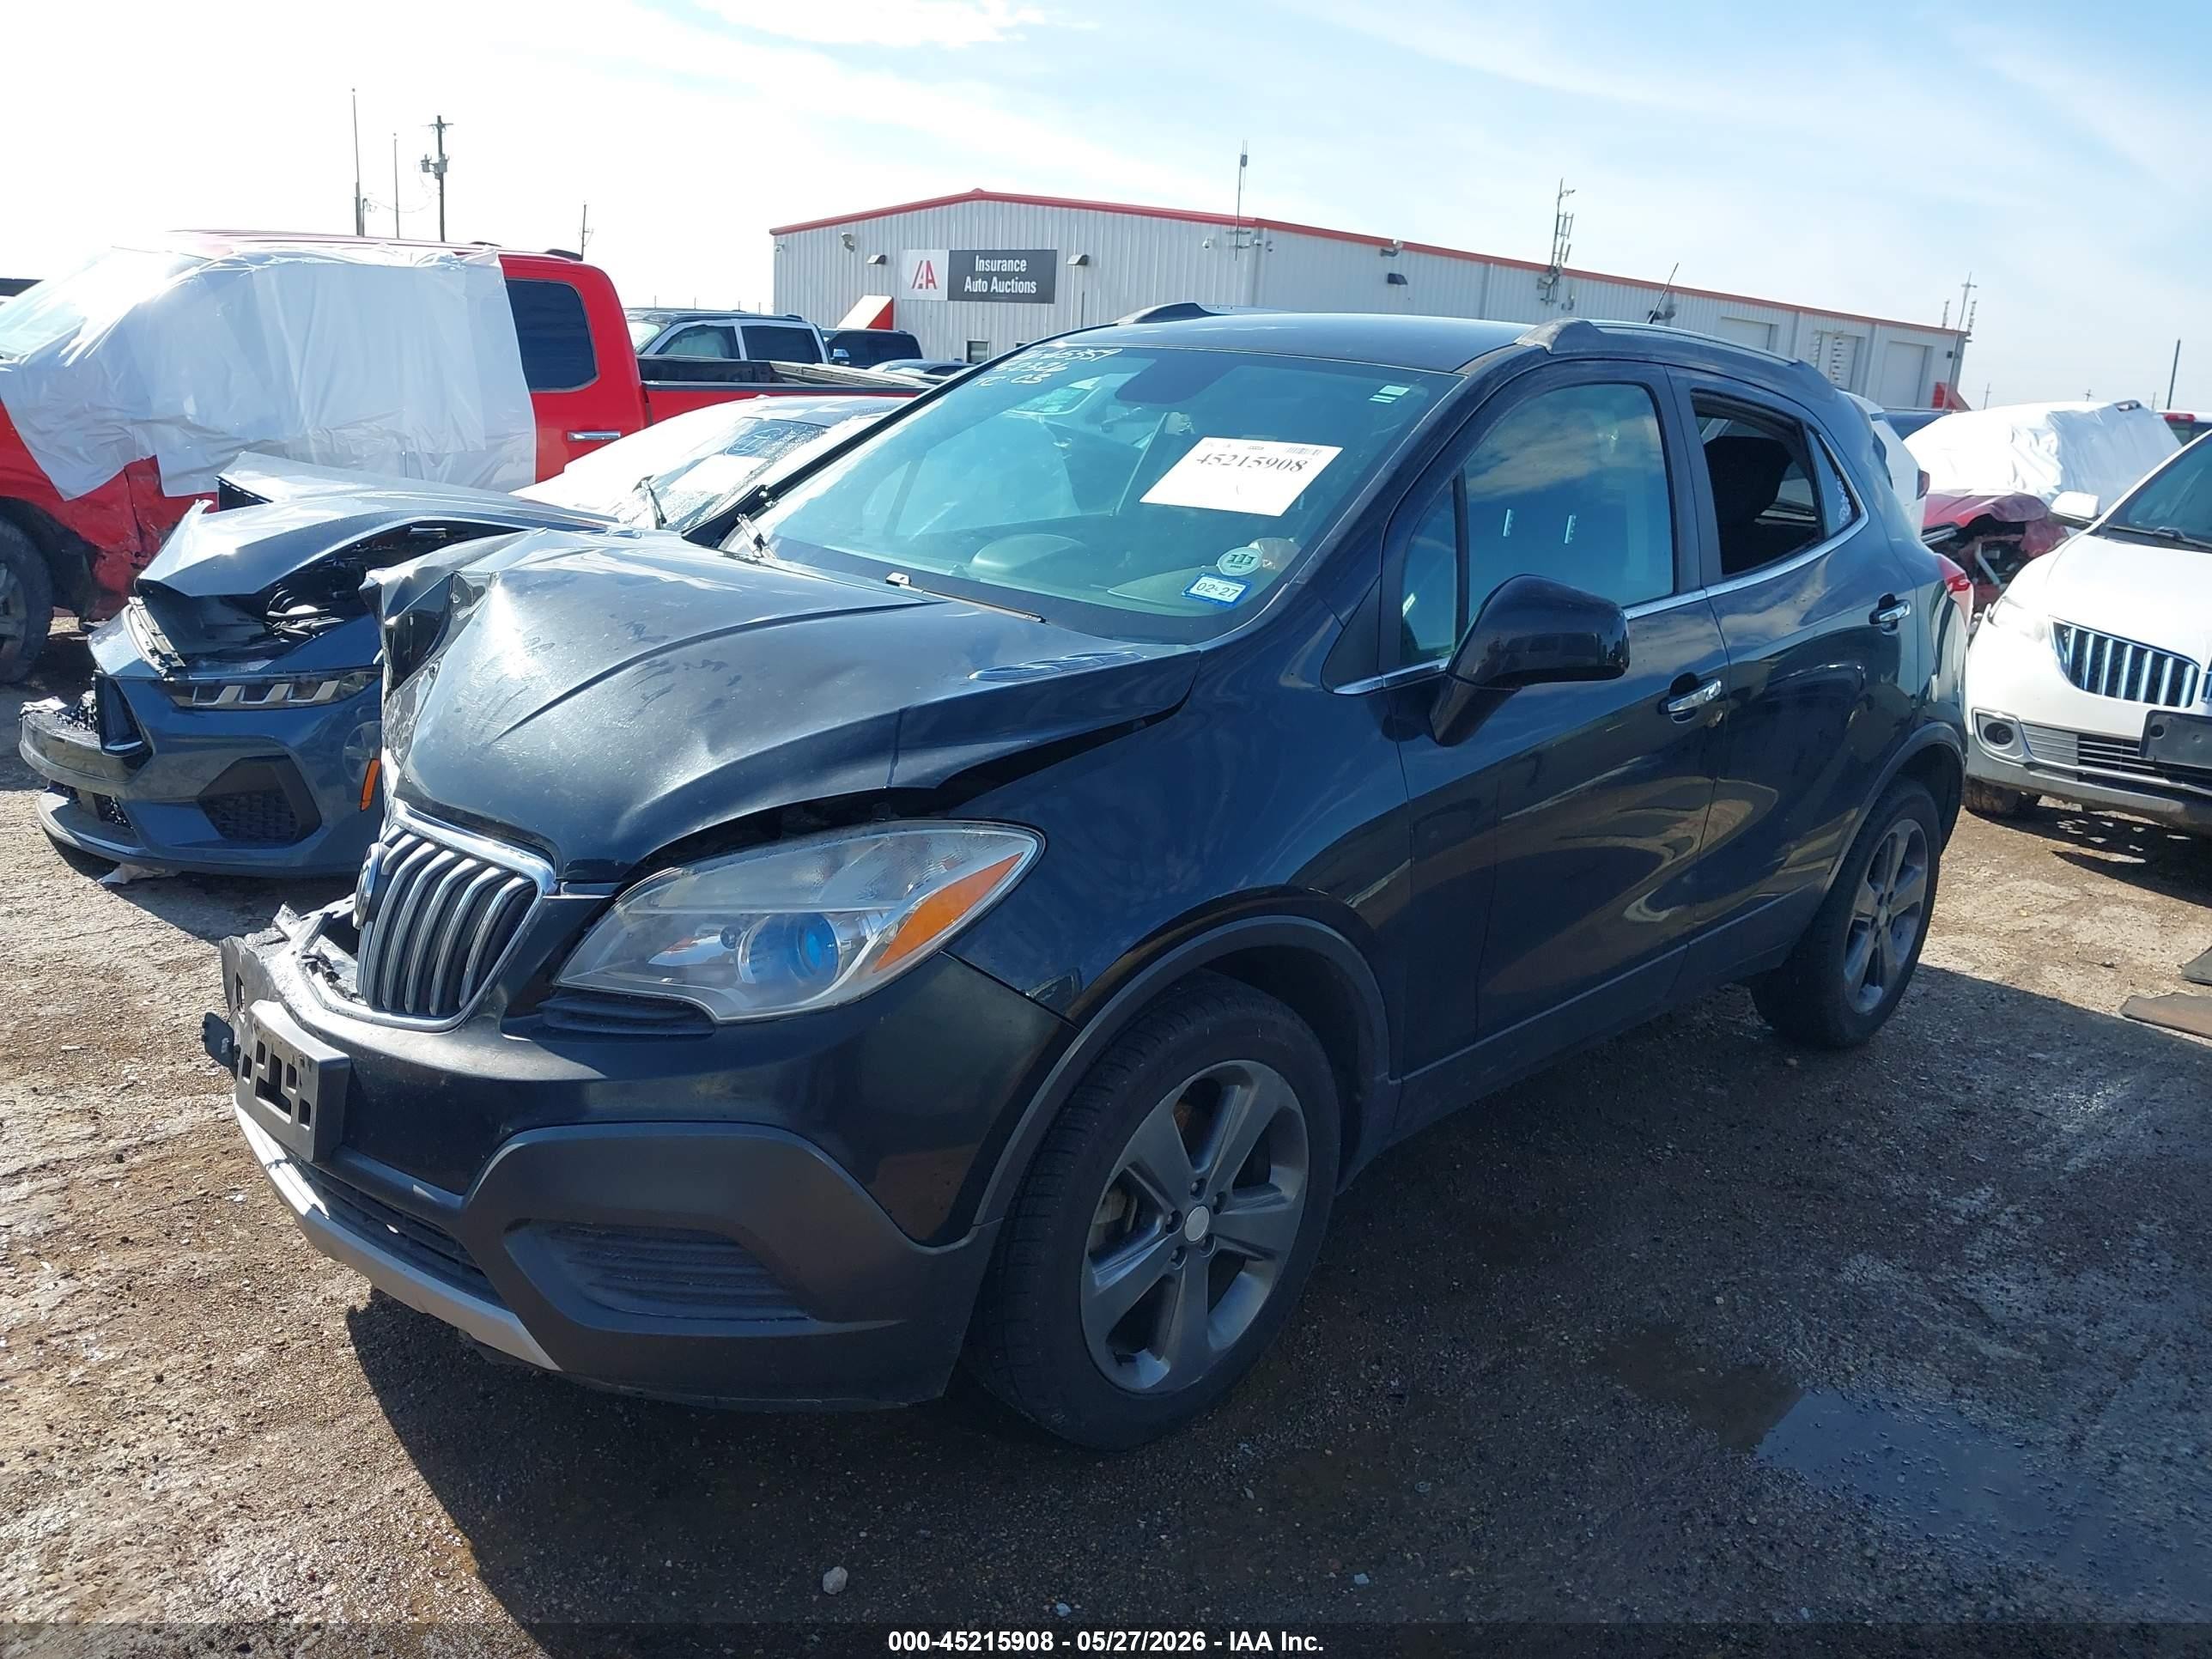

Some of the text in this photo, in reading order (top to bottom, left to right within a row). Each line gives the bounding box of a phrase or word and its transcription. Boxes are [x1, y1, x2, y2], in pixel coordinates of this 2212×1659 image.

[975, 255, 1027, 272] Insurance
[963, 276, 1037, 294] Auto Auctions
[1196, 453, 1309, 472] 45215908
